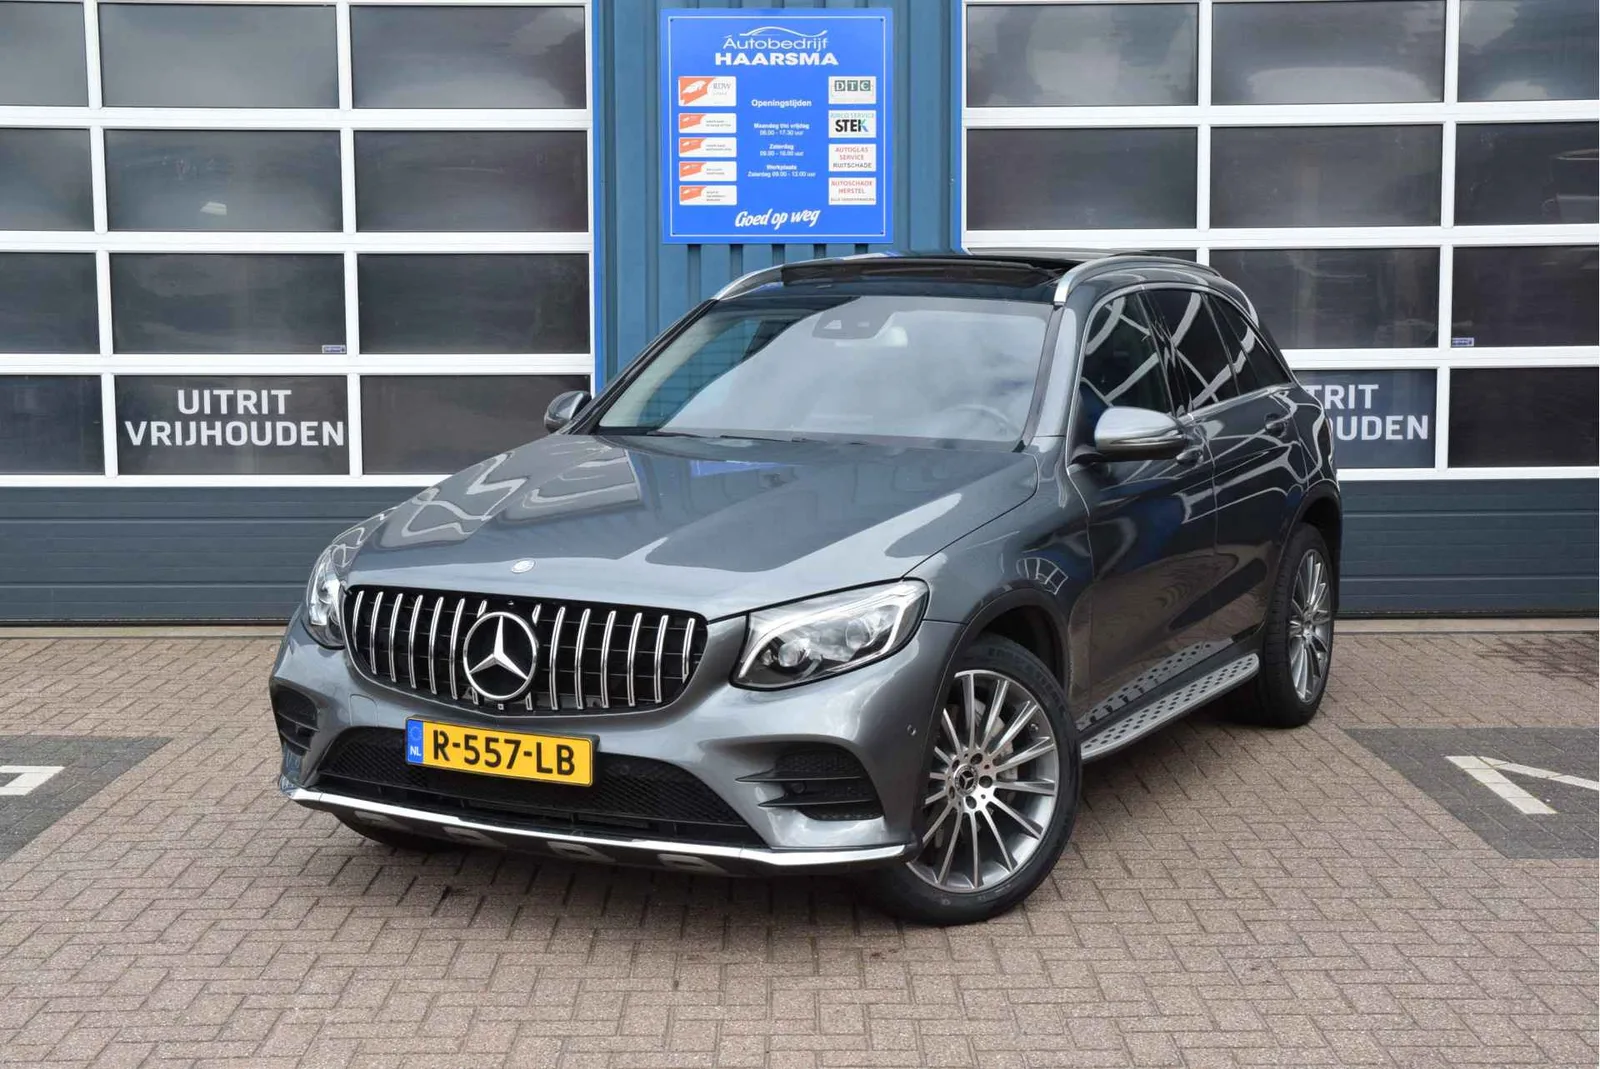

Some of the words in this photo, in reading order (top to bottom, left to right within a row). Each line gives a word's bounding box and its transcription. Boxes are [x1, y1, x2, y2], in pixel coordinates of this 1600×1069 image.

[723, 37, 827, 51] Autobedrijf
[715, 52, 839, 66] HAARSMA
[834, 79, 871, 92] DTC
[751, 98, 812, 109] Openingstijden
[835, 118, 869, 132] STEK
[735, 208, 773, 227] Goed
[771, 212, 788, 231] op
[791, 209, 821, 227] weg
[177, 389, 292, 415] UITRIT
[124, 420, 344, 447] VRIJHOUDEN
[1331, 415, 1429, 441] UDEN
[410, 746, 422, 757] NL
[432, 729, 576, 776] R-557-LB
